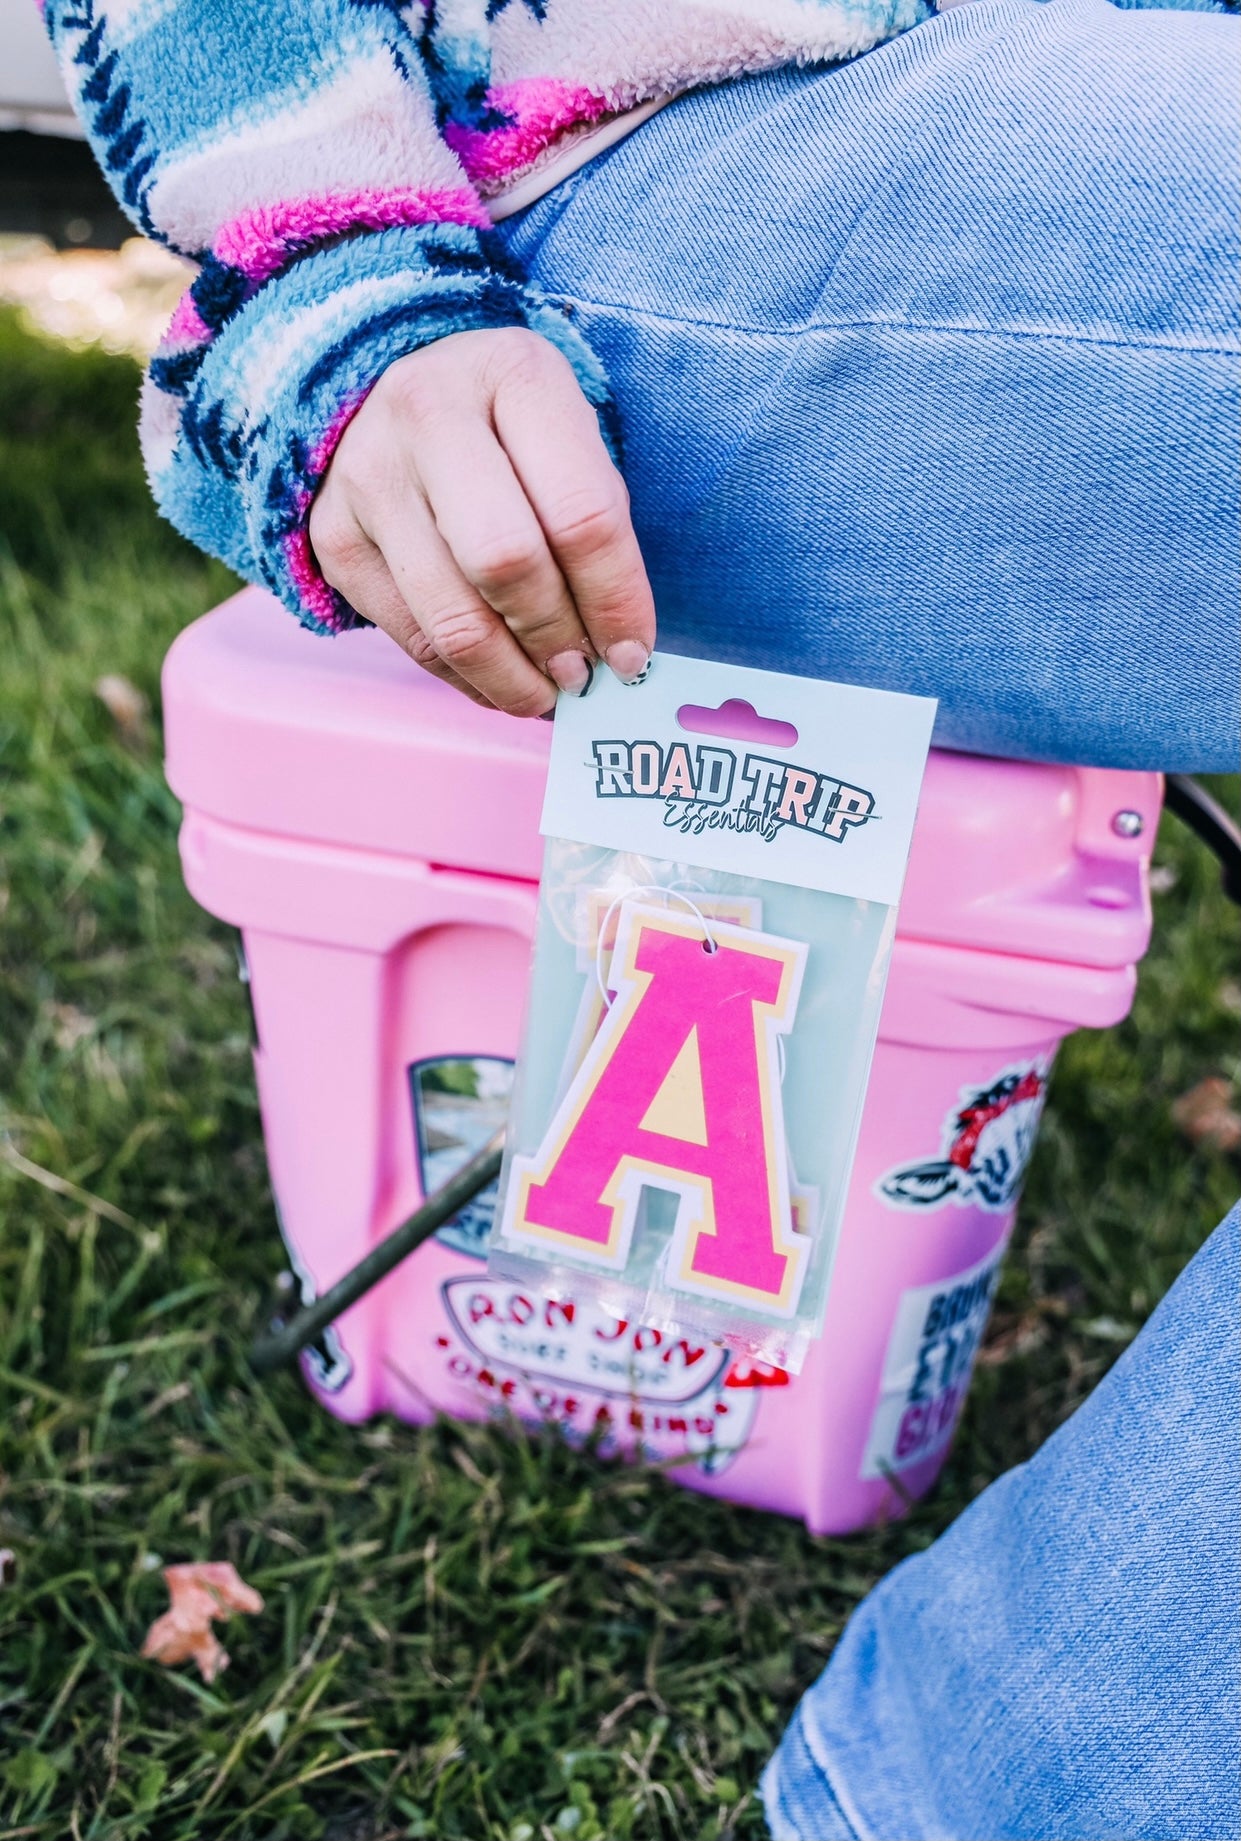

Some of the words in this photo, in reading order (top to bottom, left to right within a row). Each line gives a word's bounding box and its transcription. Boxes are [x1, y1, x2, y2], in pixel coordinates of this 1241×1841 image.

[591, 740, 738, 807] ROAD
[741, 753, 876, 844] TRIP
[662, 791, 786, 842] Essentials
[513, 912, 798, 1309] A
[469, 1294, 576, 1327] RON
[594, 1317, 706, 1367] JON
